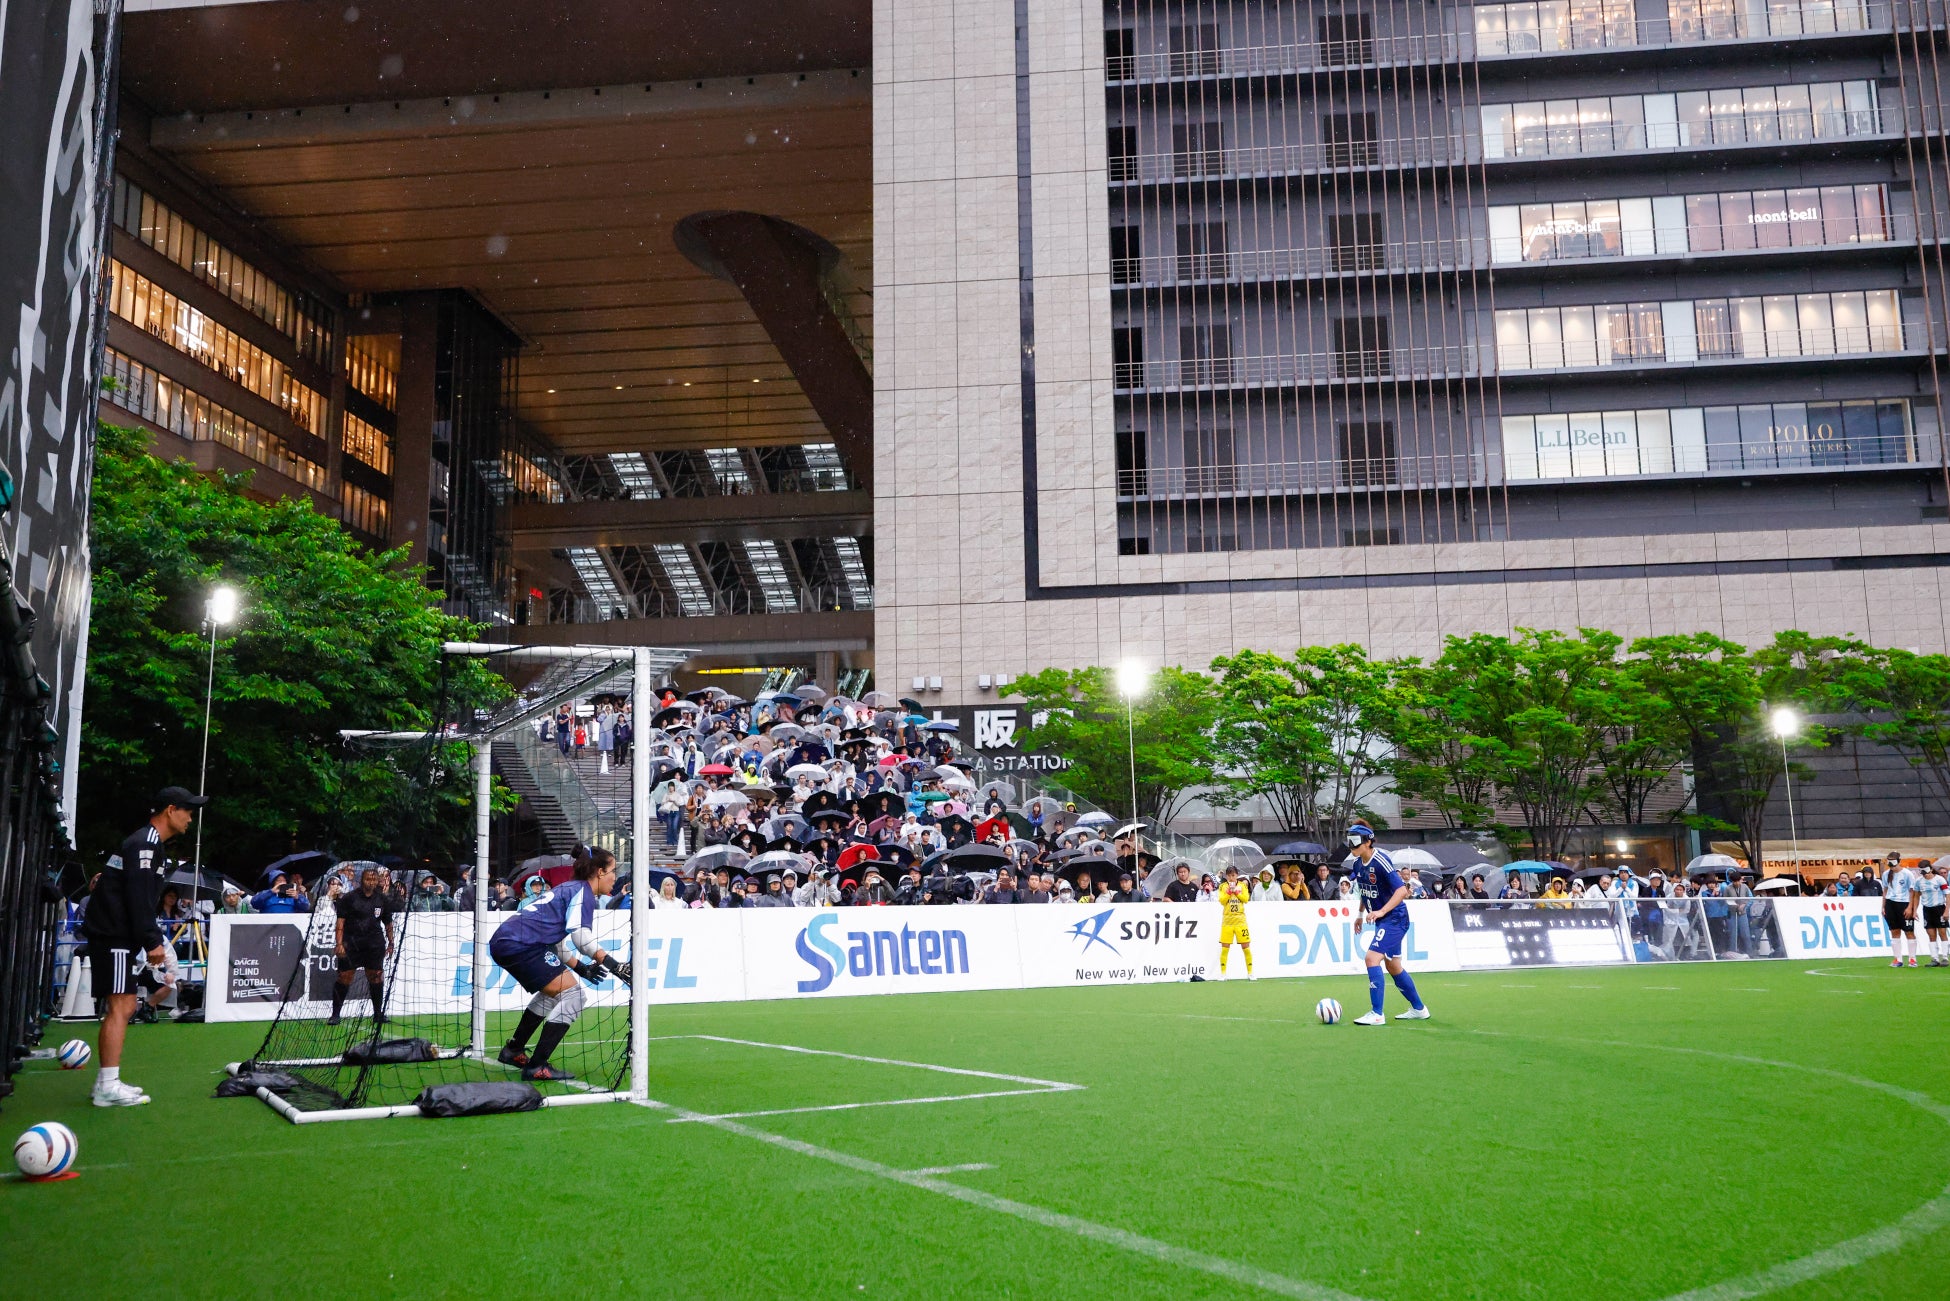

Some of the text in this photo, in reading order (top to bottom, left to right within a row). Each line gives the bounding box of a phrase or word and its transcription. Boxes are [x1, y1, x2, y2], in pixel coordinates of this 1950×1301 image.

[1538, 429, 1627, 447] L.L.Bean
[1768, 424, 1833, 442] POLO
[1750, 444, 1793, 454] RALPH
[1230, 904, 1239, 912] 23
[1465, 914, 1484, 927] PK
[1120, 913, 1198, 945] sojitz
[1241, 928, 1250, 937] 23
[1375, 928, 1386, 941] 9
[1279, 921, 1429, 966] DAICL
[795, 913, 970, 993] Santen
[233, 967, 260, 976] BLIND
[1075, 963, 1205, 980] New way, New value
[232, 978, 276, 987] FOOTBALL
